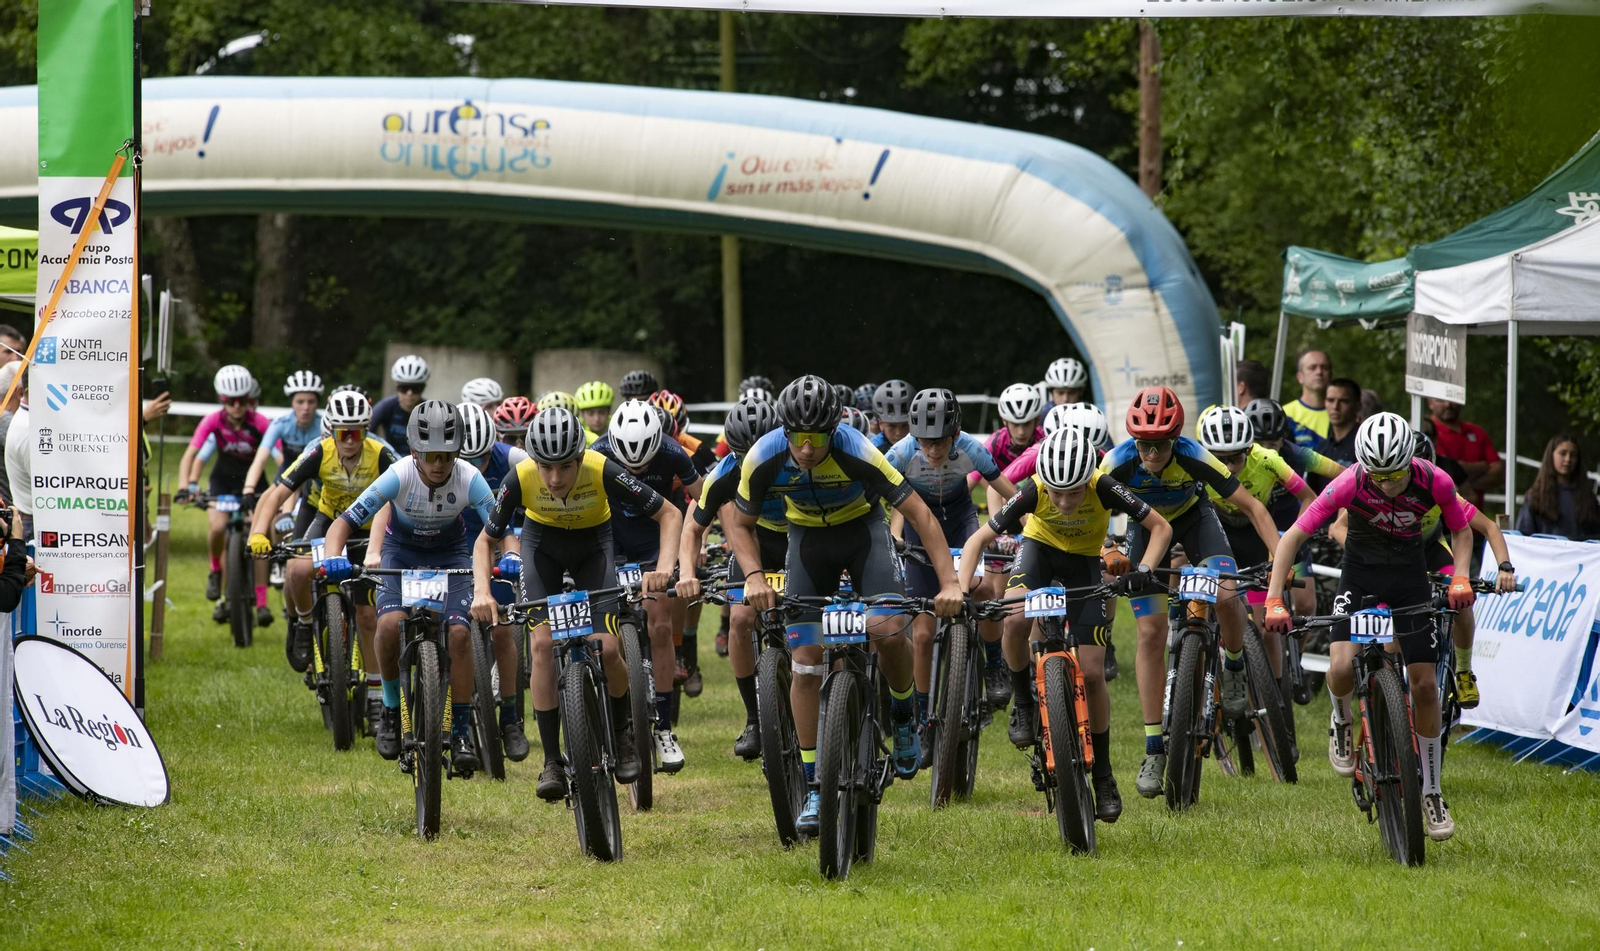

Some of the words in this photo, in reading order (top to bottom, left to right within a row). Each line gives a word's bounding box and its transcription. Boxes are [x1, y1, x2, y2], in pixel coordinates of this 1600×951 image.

[382, 98, 551, 138] ourense
[725, 182, 755, 197] sin
[41, 254, 100, 264] Acadmia
[105, 255, 133, 264] Posta
[60, 309, 106, 319] Xacobeo
[61, 338, 102, 349] XUNTA
[61, 351, 75, 361] DE
[78, 351, 128, 362] GALICIA
[1134, 372, 1189, 387] inorde
[72, 384, 114, 393] DEPORTE
[72, 392, 110, 401] GALEGO
[58, 433, 128, 443] DEPUTACIÓN
[58, 444, 109, 453] OURENSE
[34, 475, 128, 490] BICIPARQUE
[35, 496, 128, 511] CCMACEDA
[60, 532, 129, 547] PERSAN
[1182, 575, 1217, 595] 1120
[1027, 594, 1065, 610] 1105
[550, 601, 591, 629] 1102
[824, 611, 864, 635] 1103
[1353, 614, 1391, 635] 1107
[62, 626, 102, 636] inorde
[65, 641, 93, 649] urismo
[95, 640, 126, 649] Ourense
[33, 693, 72, 731] La
[64, 704, 143, 751] Región
